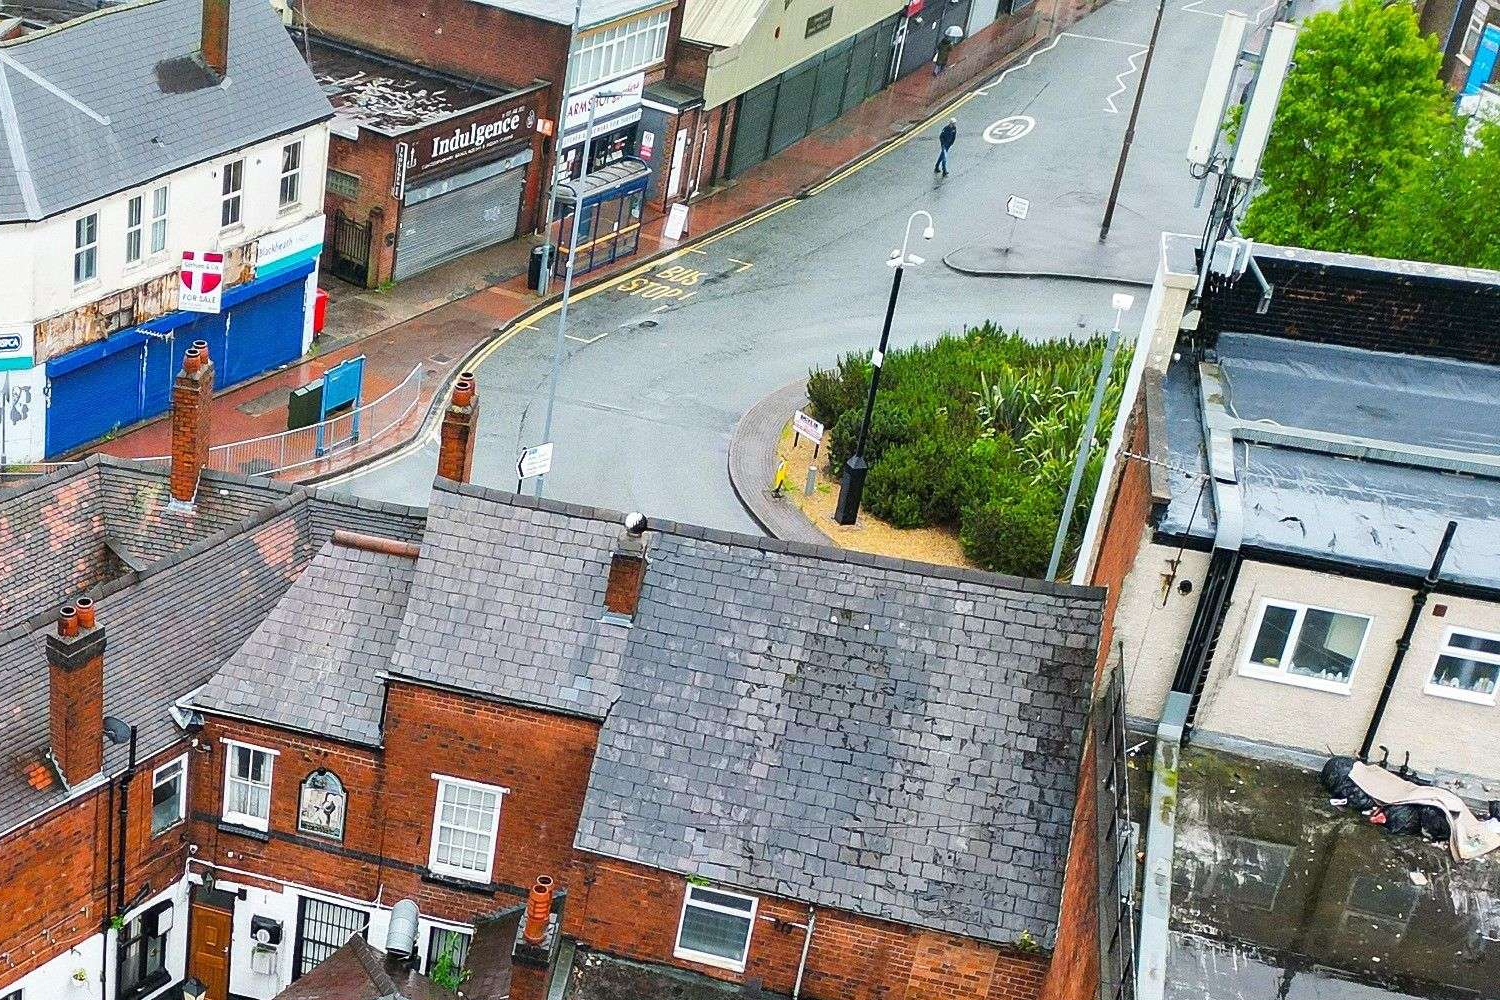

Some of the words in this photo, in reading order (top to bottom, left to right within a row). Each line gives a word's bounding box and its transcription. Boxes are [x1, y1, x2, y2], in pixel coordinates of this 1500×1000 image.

[431, 113, 520, 158] Indulgence
[992, 122, 1025, 136] 20
[656, 265, 708, 286] BUS
[182, 293, 197, 301] FOR
[199, 295, 217, 303] SALE
[617, 278, 683, 300] STOP
